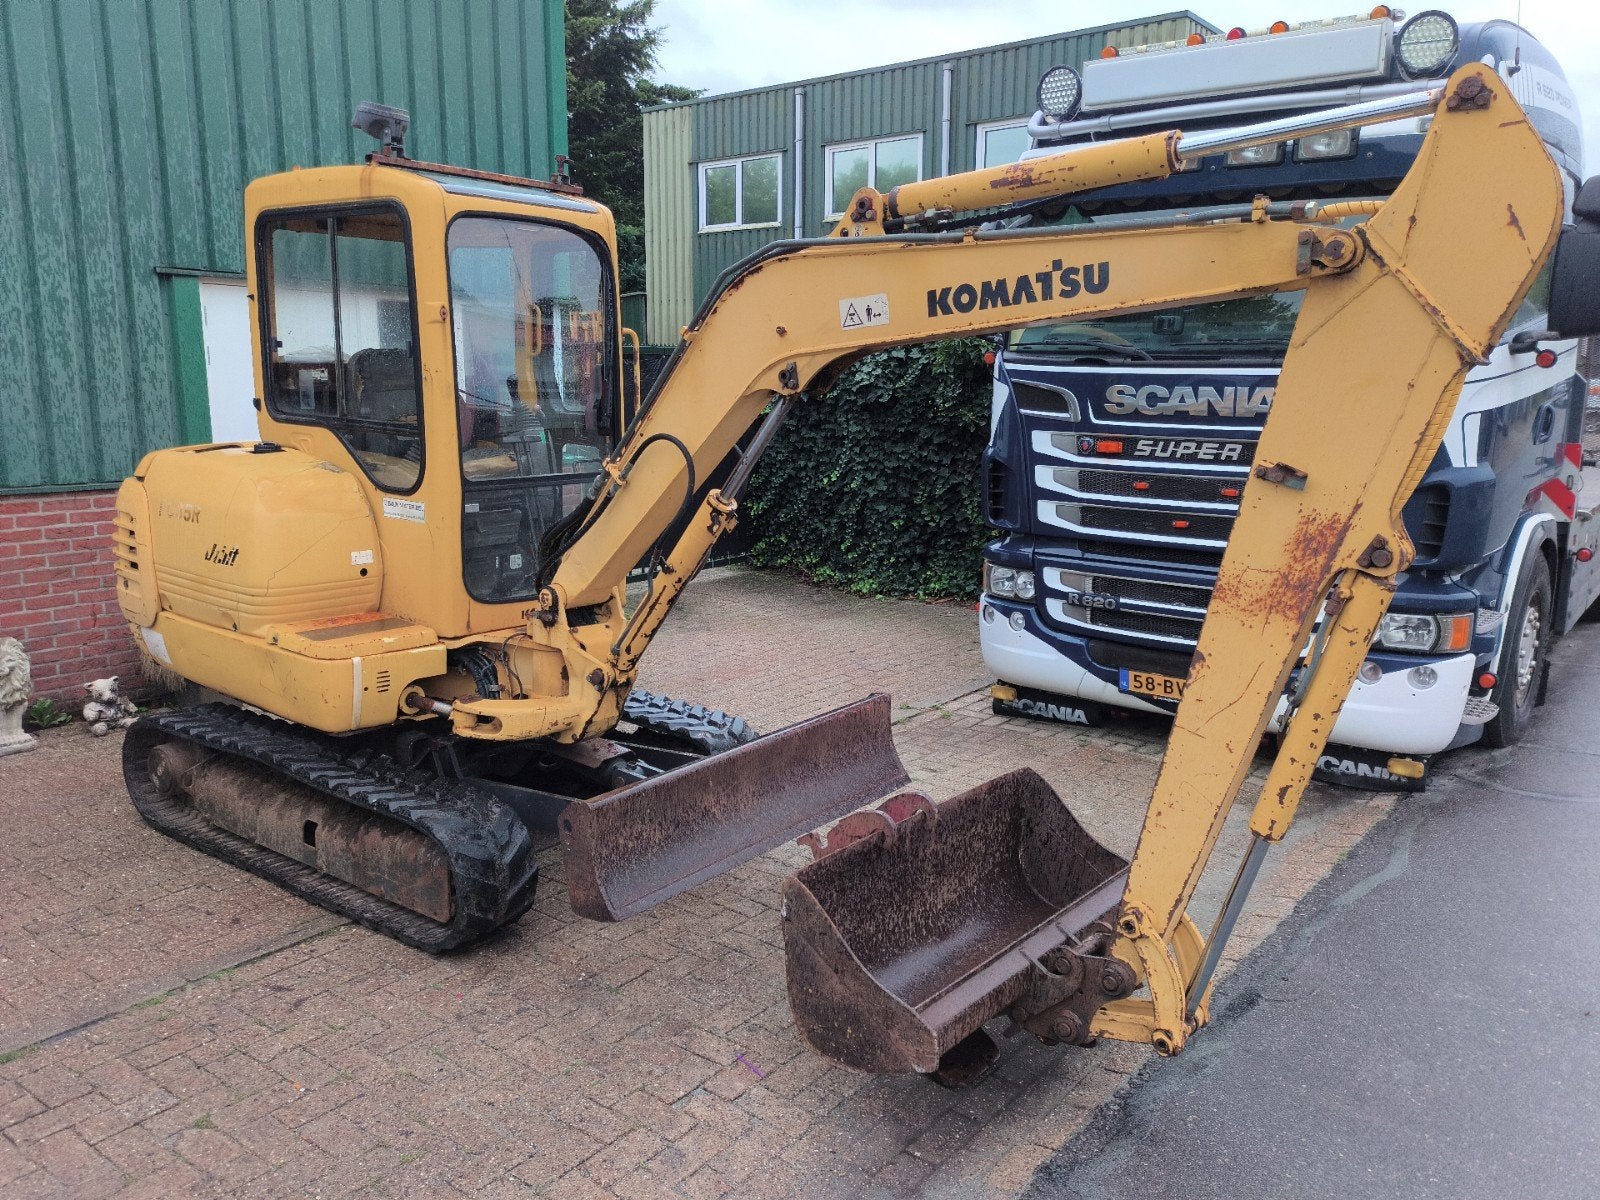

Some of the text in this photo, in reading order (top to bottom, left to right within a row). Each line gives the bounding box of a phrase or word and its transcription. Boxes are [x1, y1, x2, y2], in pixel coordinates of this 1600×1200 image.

[927, 259, 1110, 318] KOMATSU
[1104, 384, 1275, 417] SCANIA
[1134, 439, 1243, 461] SUPER
[1068, 593, 1080, 605] R
